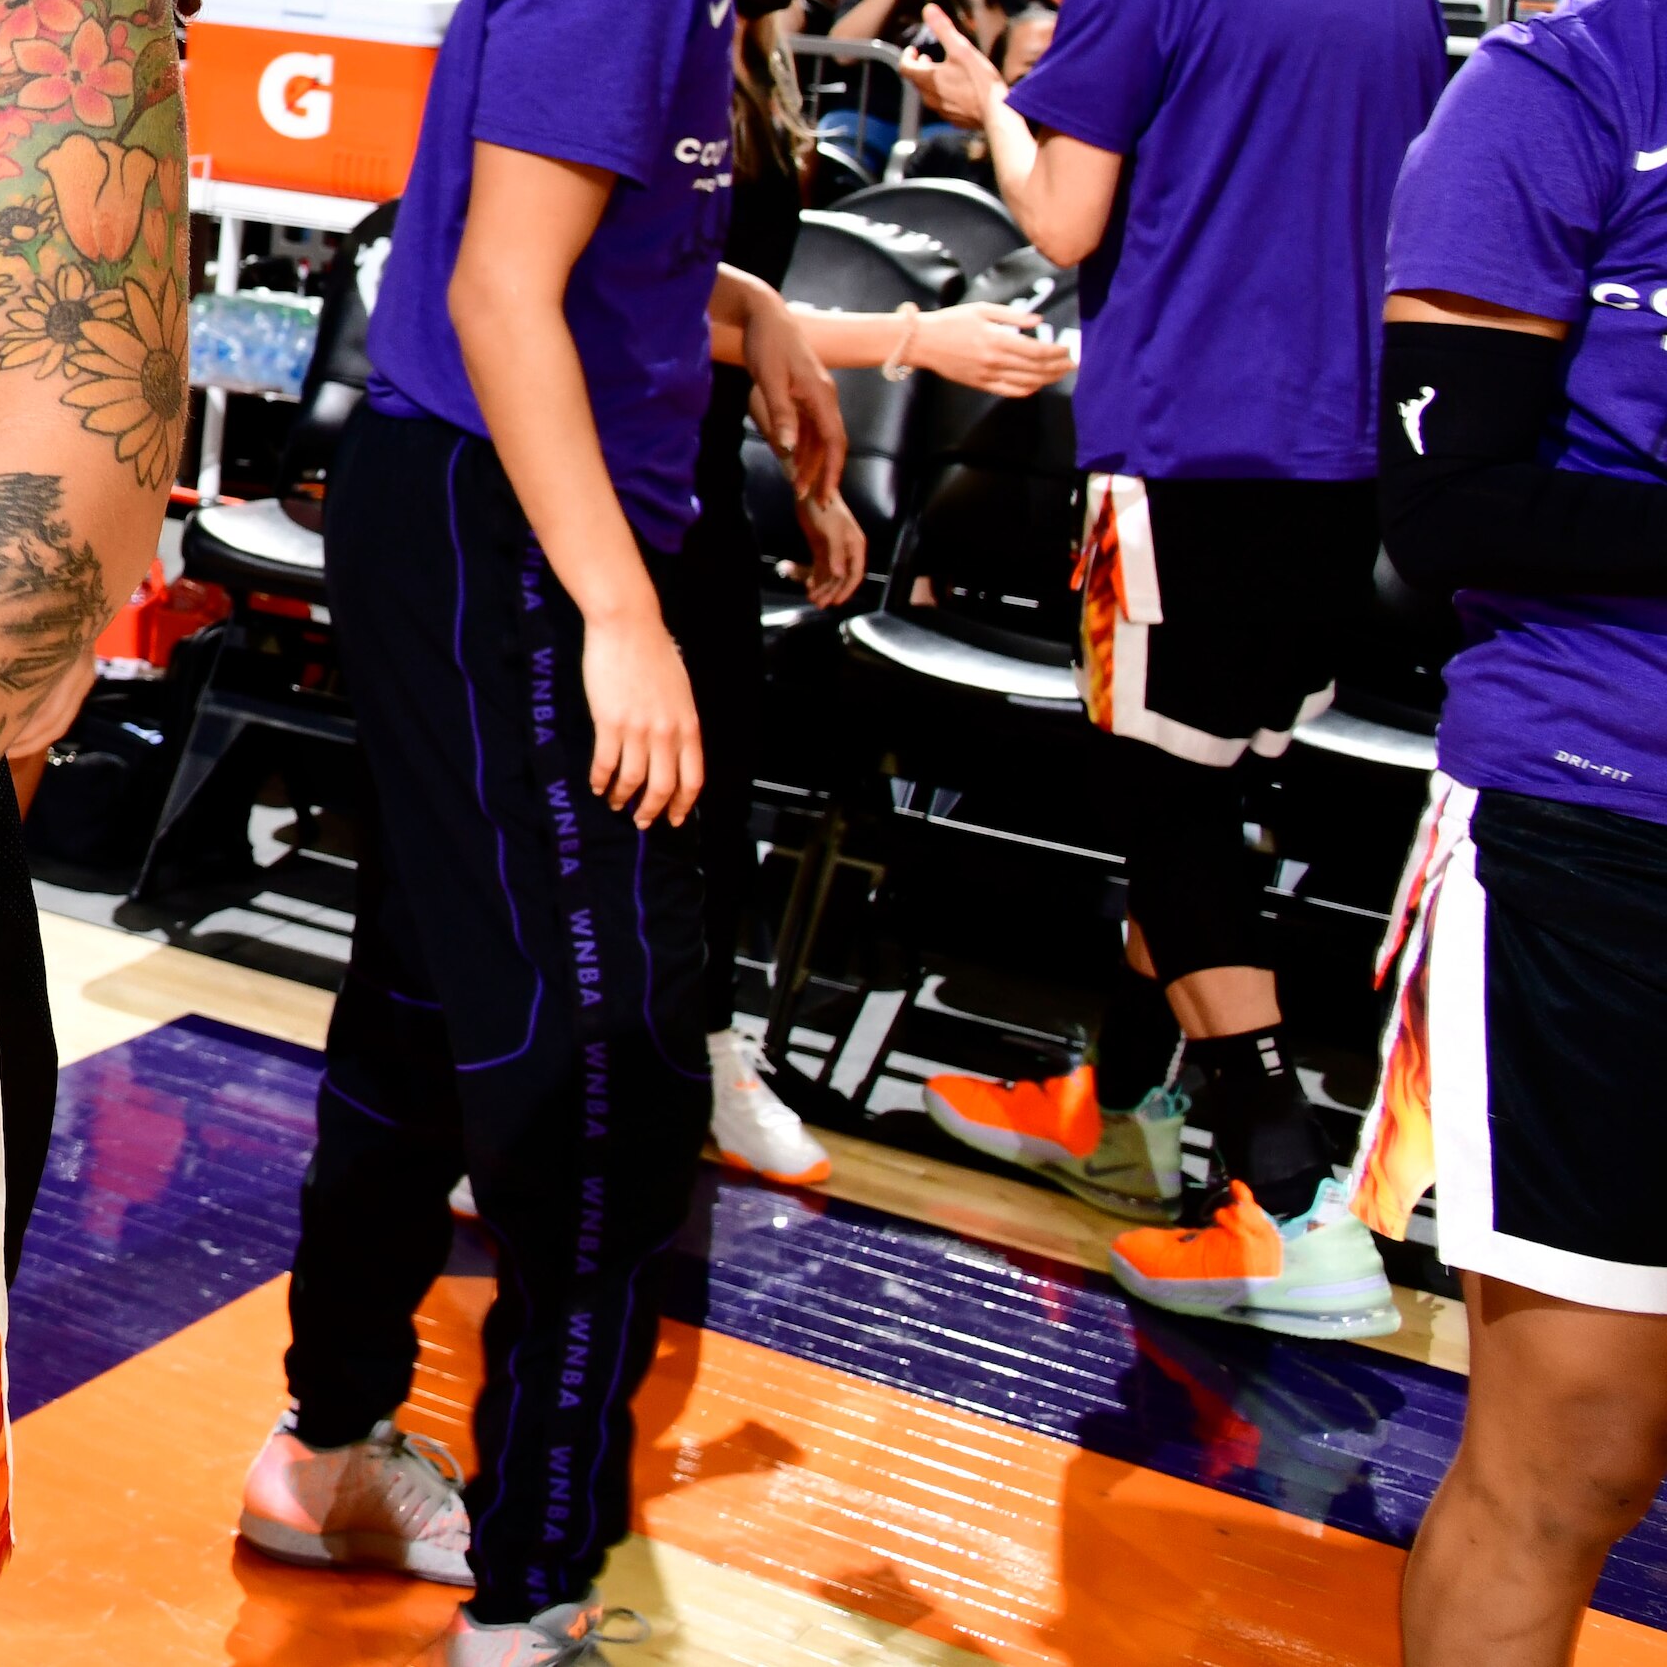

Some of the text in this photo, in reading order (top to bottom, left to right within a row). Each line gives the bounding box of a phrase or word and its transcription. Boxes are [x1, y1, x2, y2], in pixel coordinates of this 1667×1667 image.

[258, 51, 334, 139] G
[531, 645, 557, 747] WNBA
[1553, 749, 1634, 783] DRI-FIT
[546, 778, 583, 878] WNBA
[569, 907, 604, 1007] WNBA
[582, 1040, 609, 1139] WNBA
[574, 1176, 603, 1274] WNBA
[557, 1311, 594, 1411] WNBA
[542, 1444, 575, 1544] WNBA
